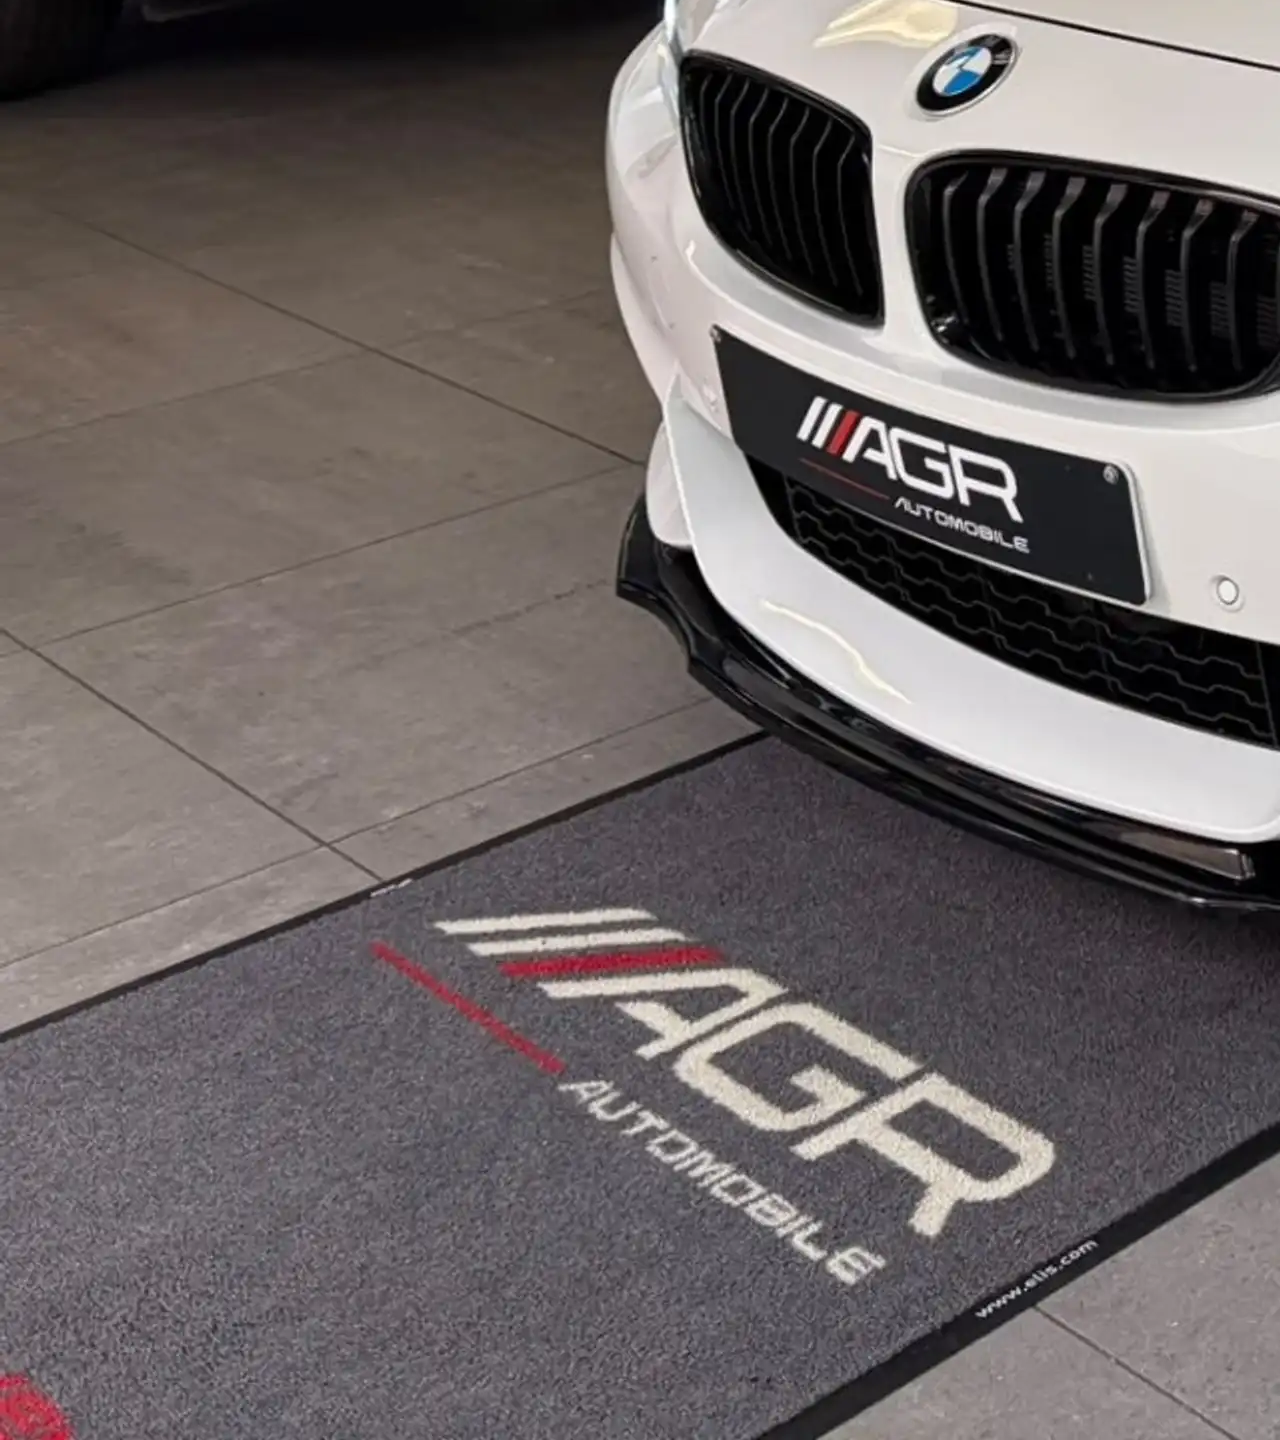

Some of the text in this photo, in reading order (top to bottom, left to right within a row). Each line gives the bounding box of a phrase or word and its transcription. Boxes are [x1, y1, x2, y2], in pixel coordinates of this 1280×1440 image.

[842, 415, 1024, 524] AGR
[894, 496, 1030, 554] AUTOMOBILE
[538, 967, 1056, 1239] AGR
[558, 1079, 886, 1286] AUTOMOBILE
[974, 1239, 1100, 1319] www.elis.com
